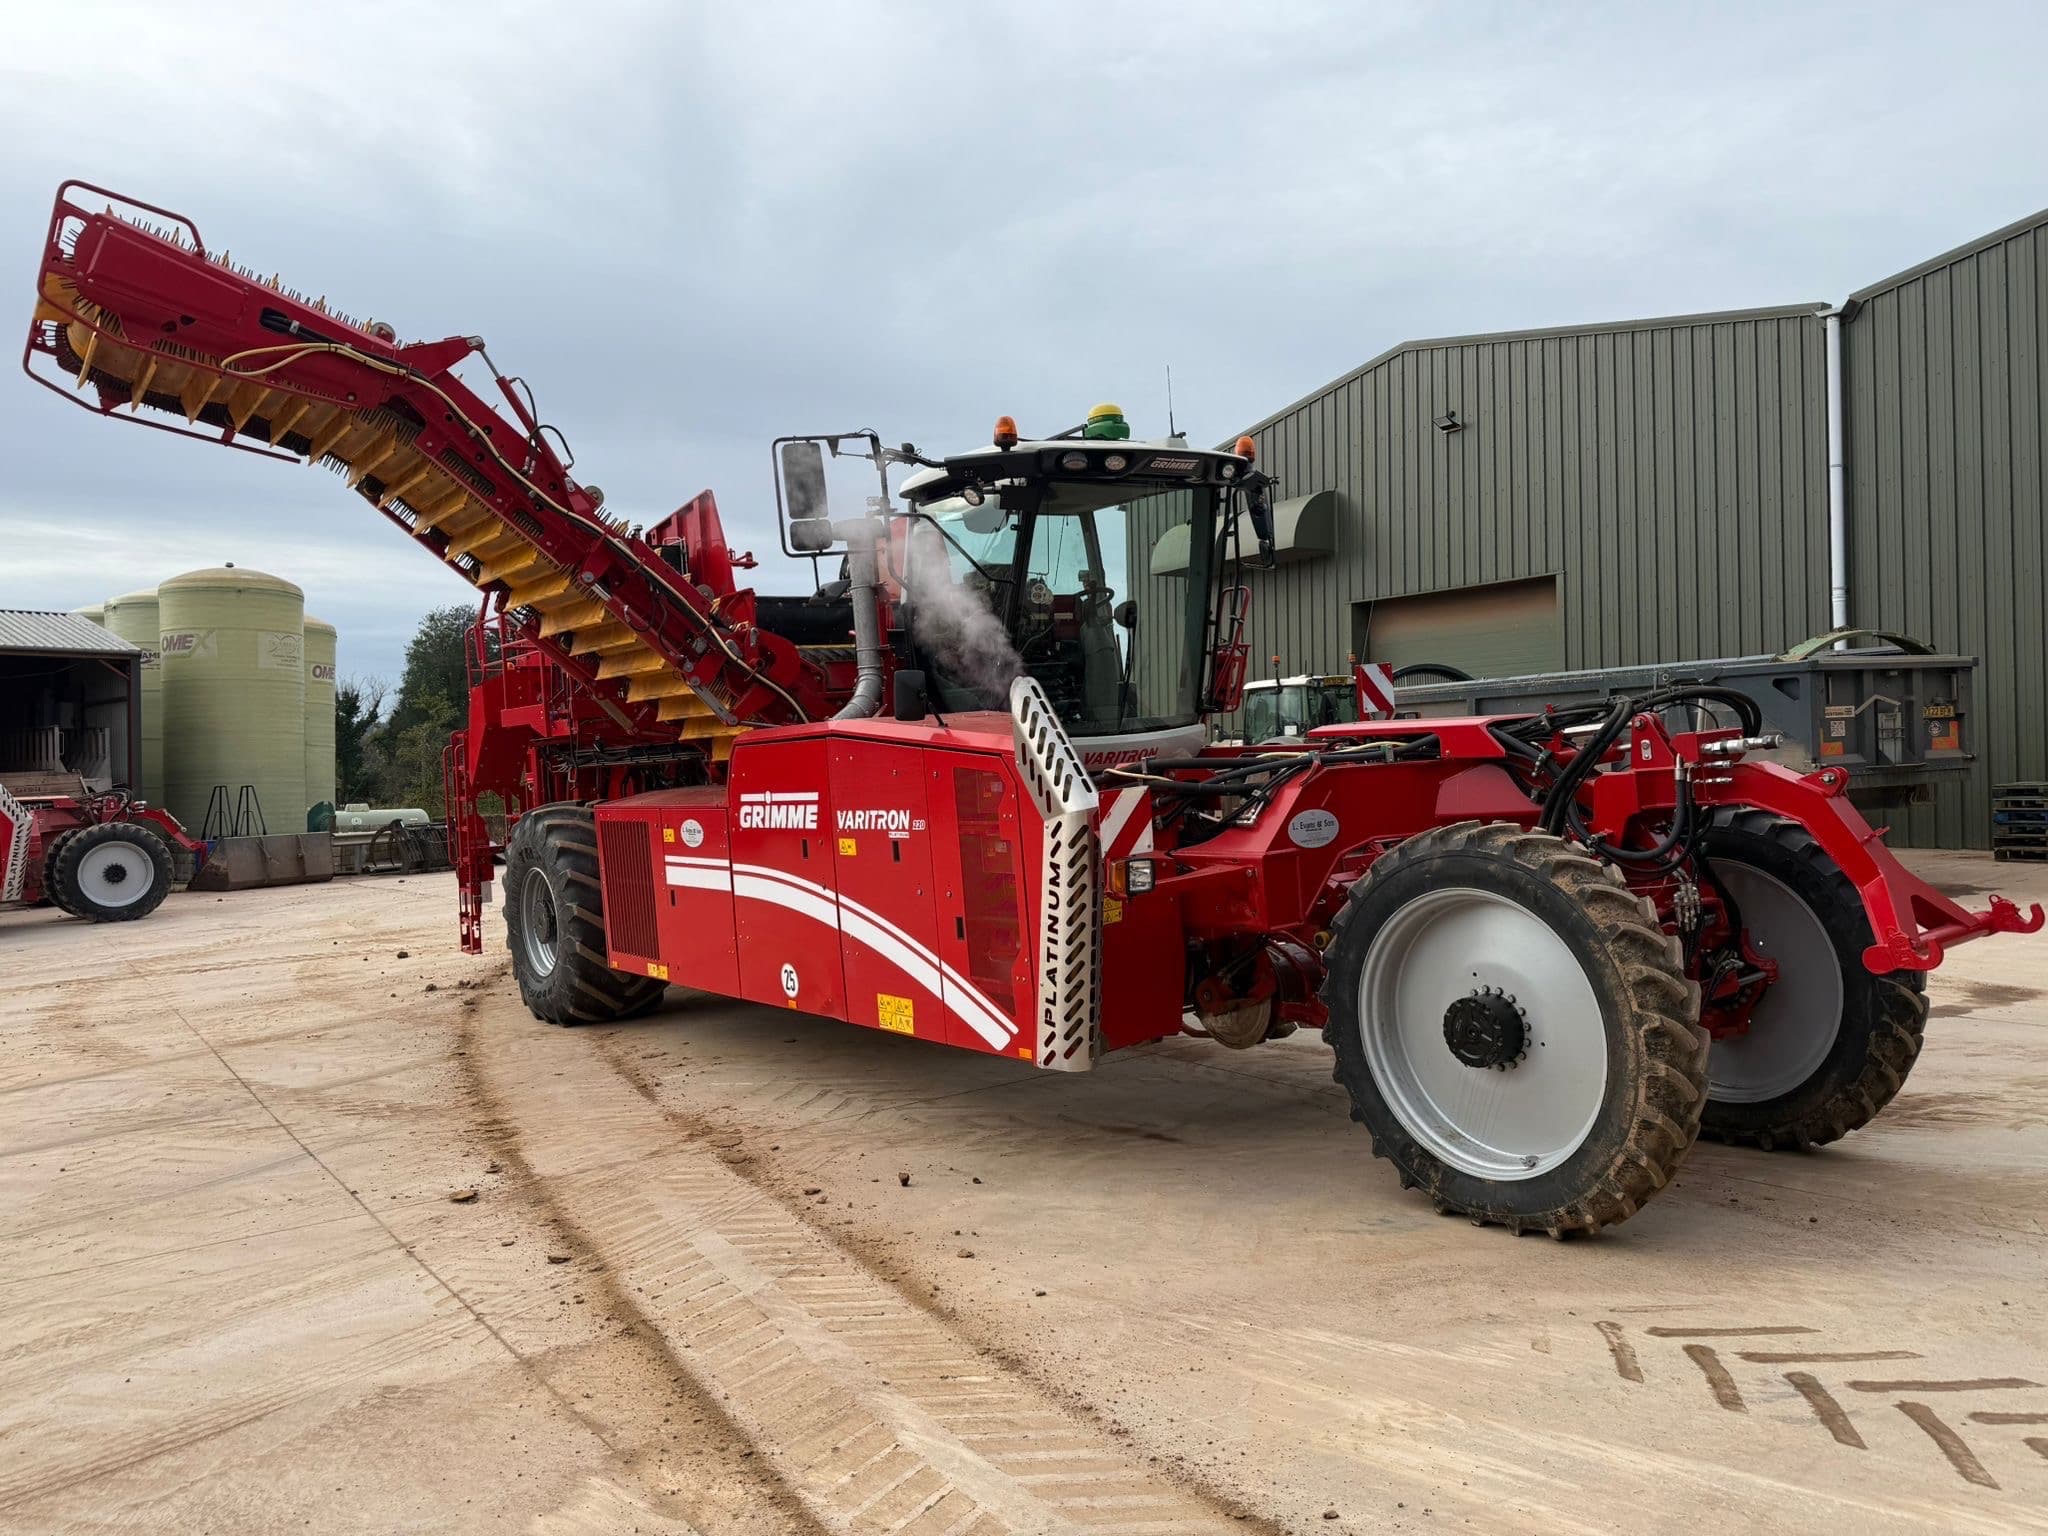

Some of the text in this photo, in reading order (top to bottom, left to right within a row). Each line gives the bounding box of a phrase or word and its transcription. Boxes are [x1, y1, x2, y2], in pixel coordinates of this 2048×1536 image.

[1151, 460, 1197, 470] GRIMME
[1084, 747, 1158, 765] VARITRON
[739, 803, 818, 830] GRIMME
[837, 810, 910, 831] VARITRON
[8, 835, 21, 888] PLATINUM
[1044, 861, 1061, 1028] PLATINUM
[784, 969, 796, 992] 25
